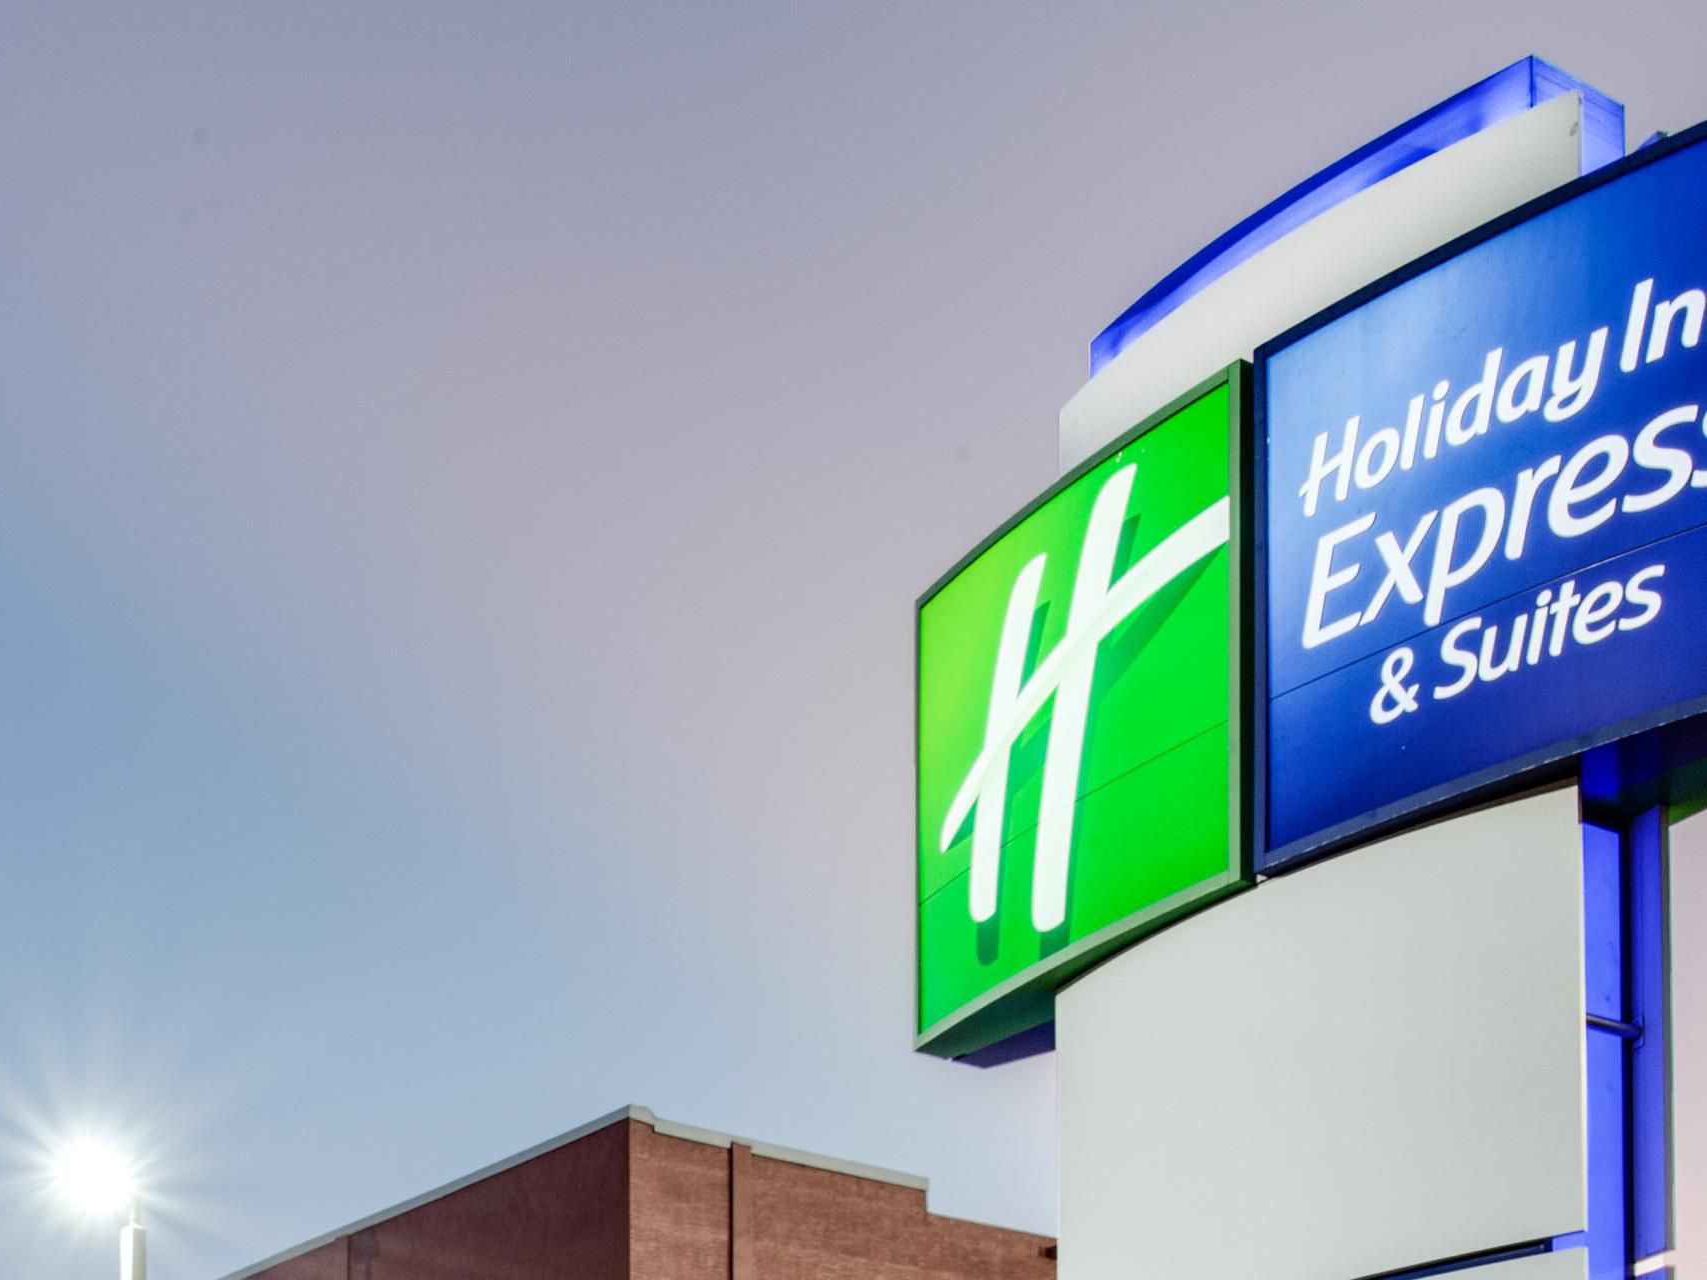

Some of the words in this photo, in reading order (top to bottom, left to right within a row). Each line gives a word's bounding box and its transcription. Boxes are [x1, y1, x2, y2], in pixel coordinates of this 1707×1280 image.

[1298, 327, 1608, 518] Holiday
[1301, 405, 1707, 649] Expres
[1369, 646, 1420, 725] &
[1433, 564, 1666, 699] Suites
